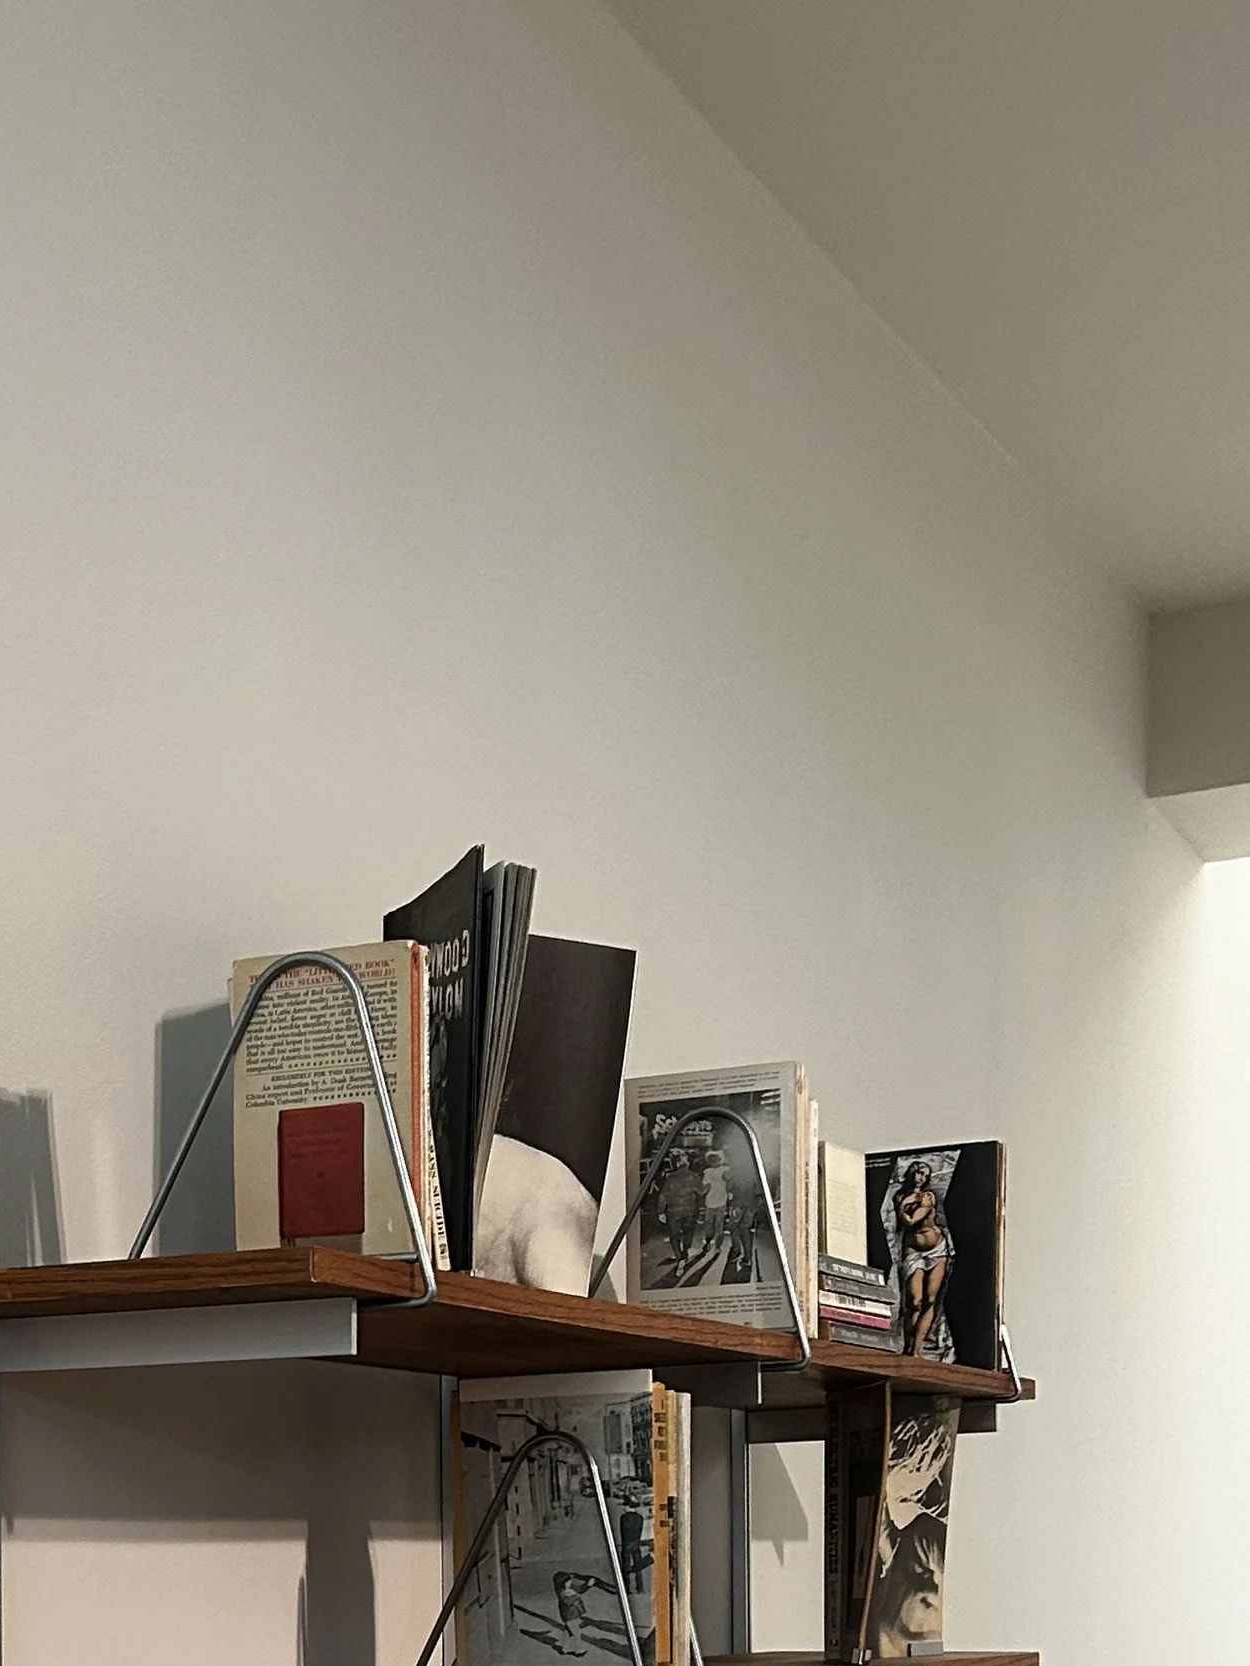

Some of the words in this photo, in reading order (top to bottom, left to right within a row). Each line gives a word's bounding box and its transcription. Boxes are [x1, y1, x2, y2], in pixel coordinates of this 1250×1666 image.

[429, 929, 470, 979] YWOOD
[298, 976, 335, 988] SHAKEN
[431, 978, 464, 1020] YLON
